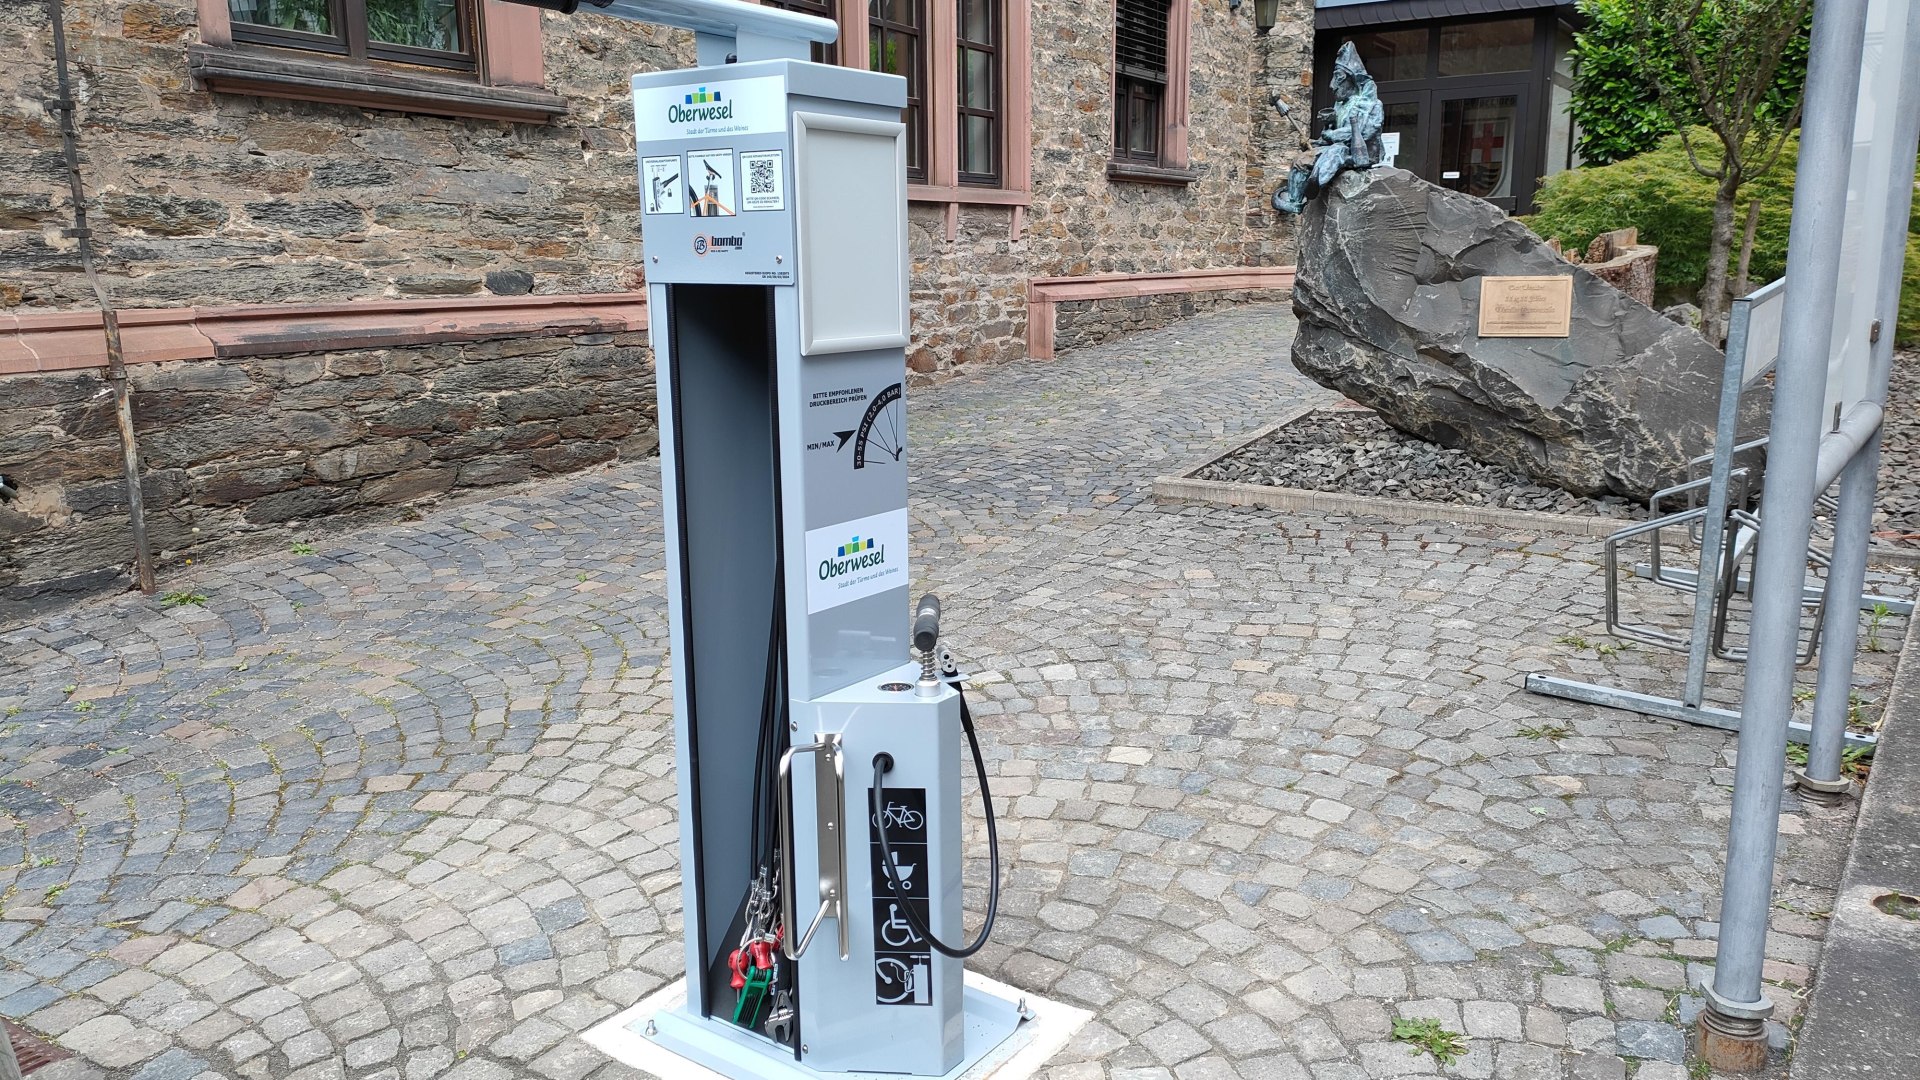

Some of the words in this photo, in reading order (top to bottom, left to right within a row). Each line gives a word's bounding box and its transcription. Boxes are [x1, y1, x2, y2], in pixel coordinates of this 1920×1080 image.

[668, 99, 733, 123] Oberwesel
[809, 397, 848, 408] DRUCKBEREICH
[848, 394, 867, 402] PRÜFEN
[812, 391, 828, 399] BITTE
[828, 387, 864, 398] EMPFOHLENEN
[856, 440, 864, 467] 30-55
[860, 422, 868, 438] PSI
[819, 544, 885, 580] Oberwesel
[837, 580, 849, 589] Stadt
